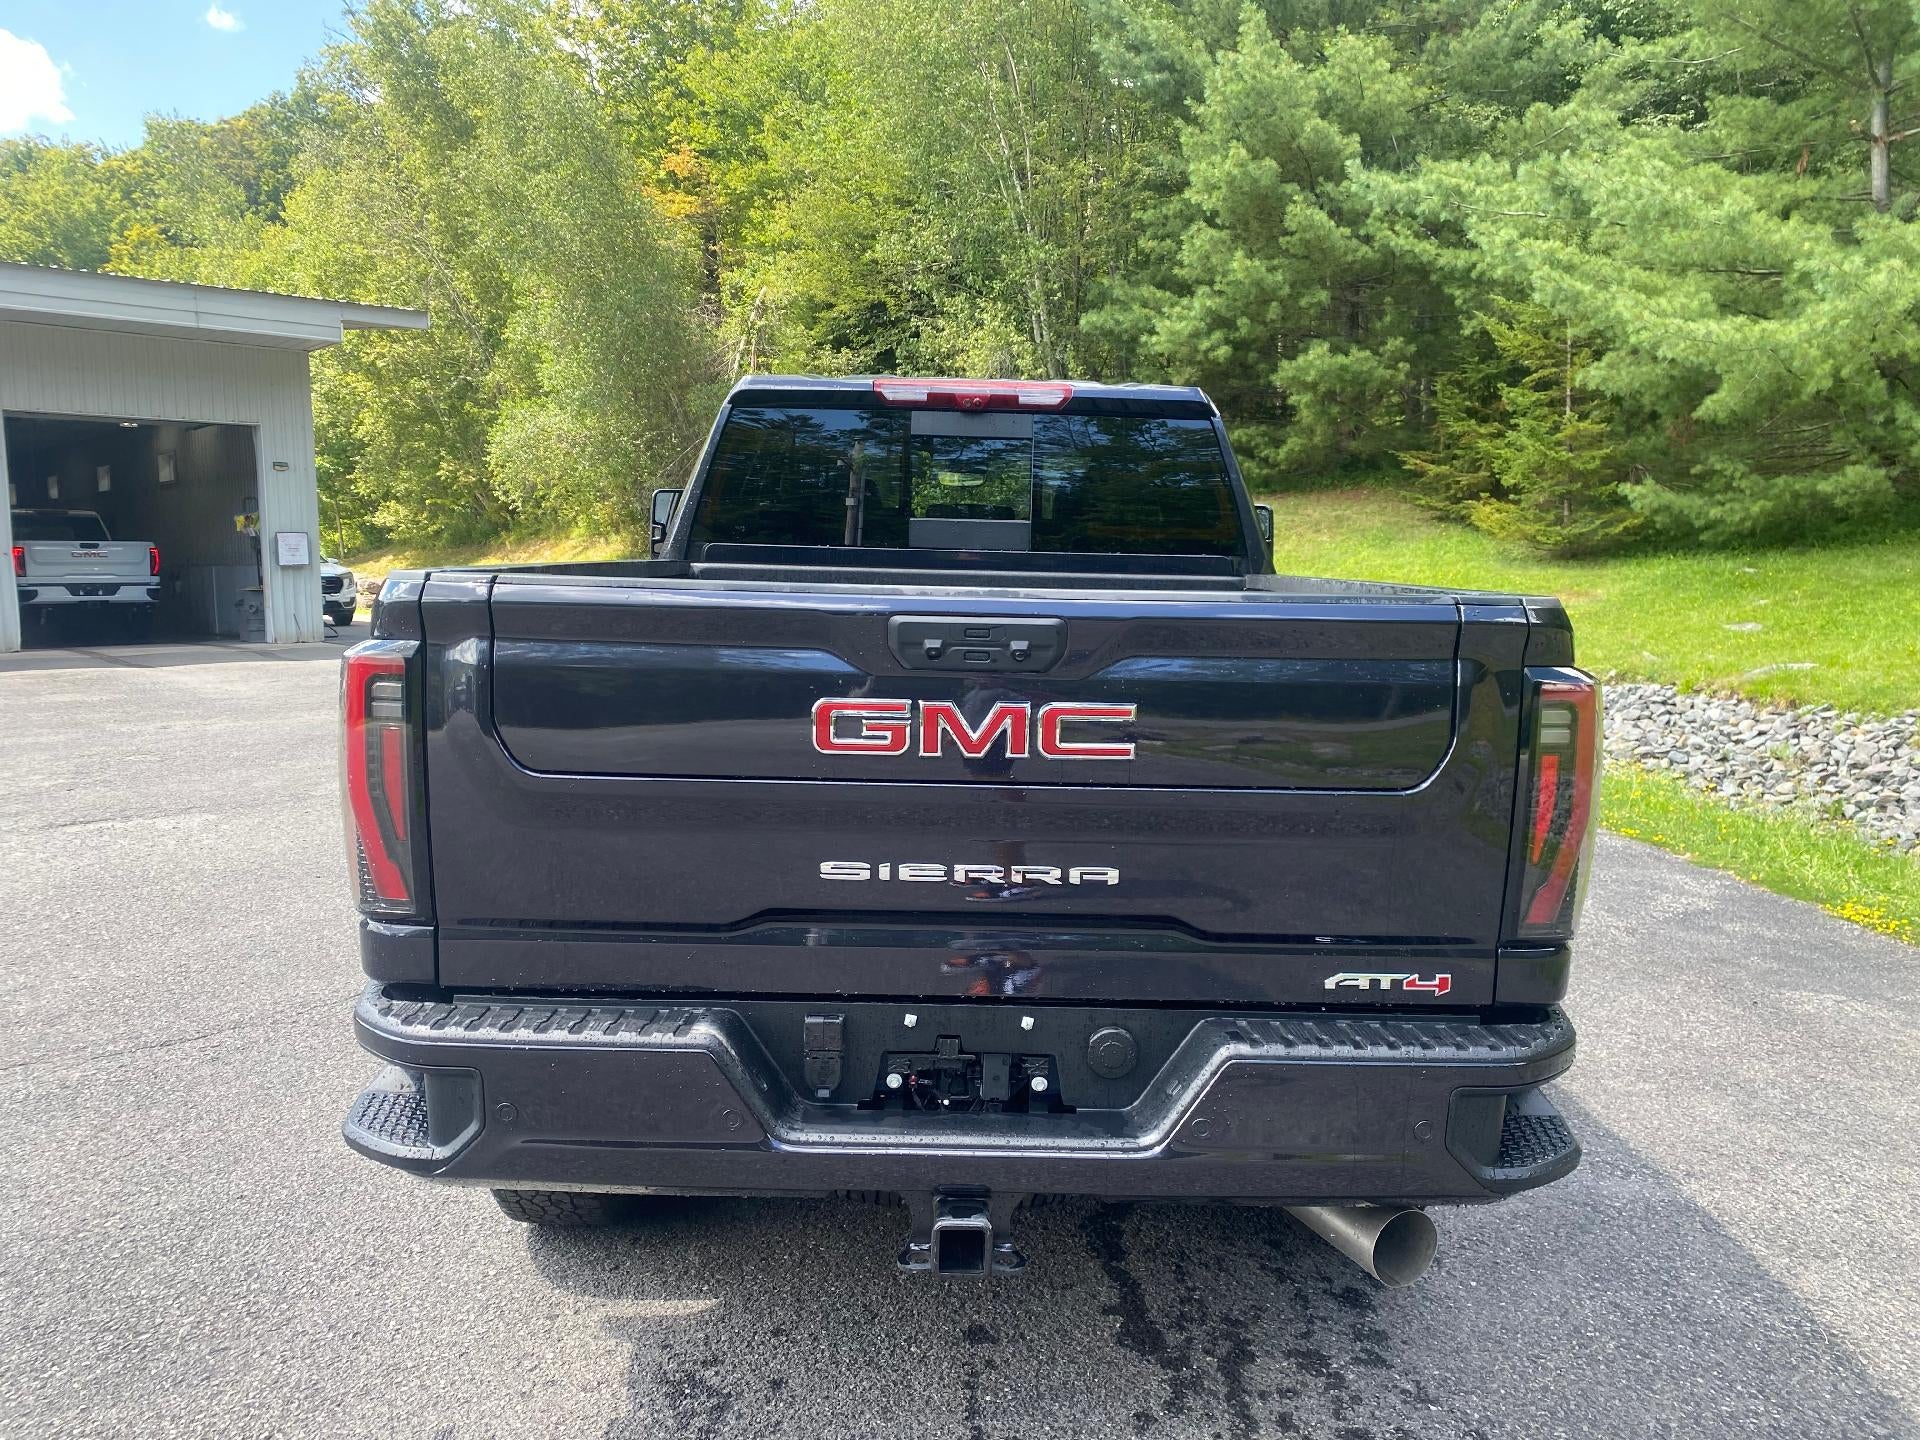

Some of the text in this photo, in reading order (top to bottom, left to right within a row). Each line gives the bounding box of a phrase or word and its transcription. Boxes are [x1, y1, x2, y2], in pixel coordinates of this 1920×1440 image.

[71, 550, 109, 558] GMC
[811, 698, 1137, 760] GMC
[819, 861, 1120, 886] SIERRA
[1324, 972, 1452, 997] AT4
